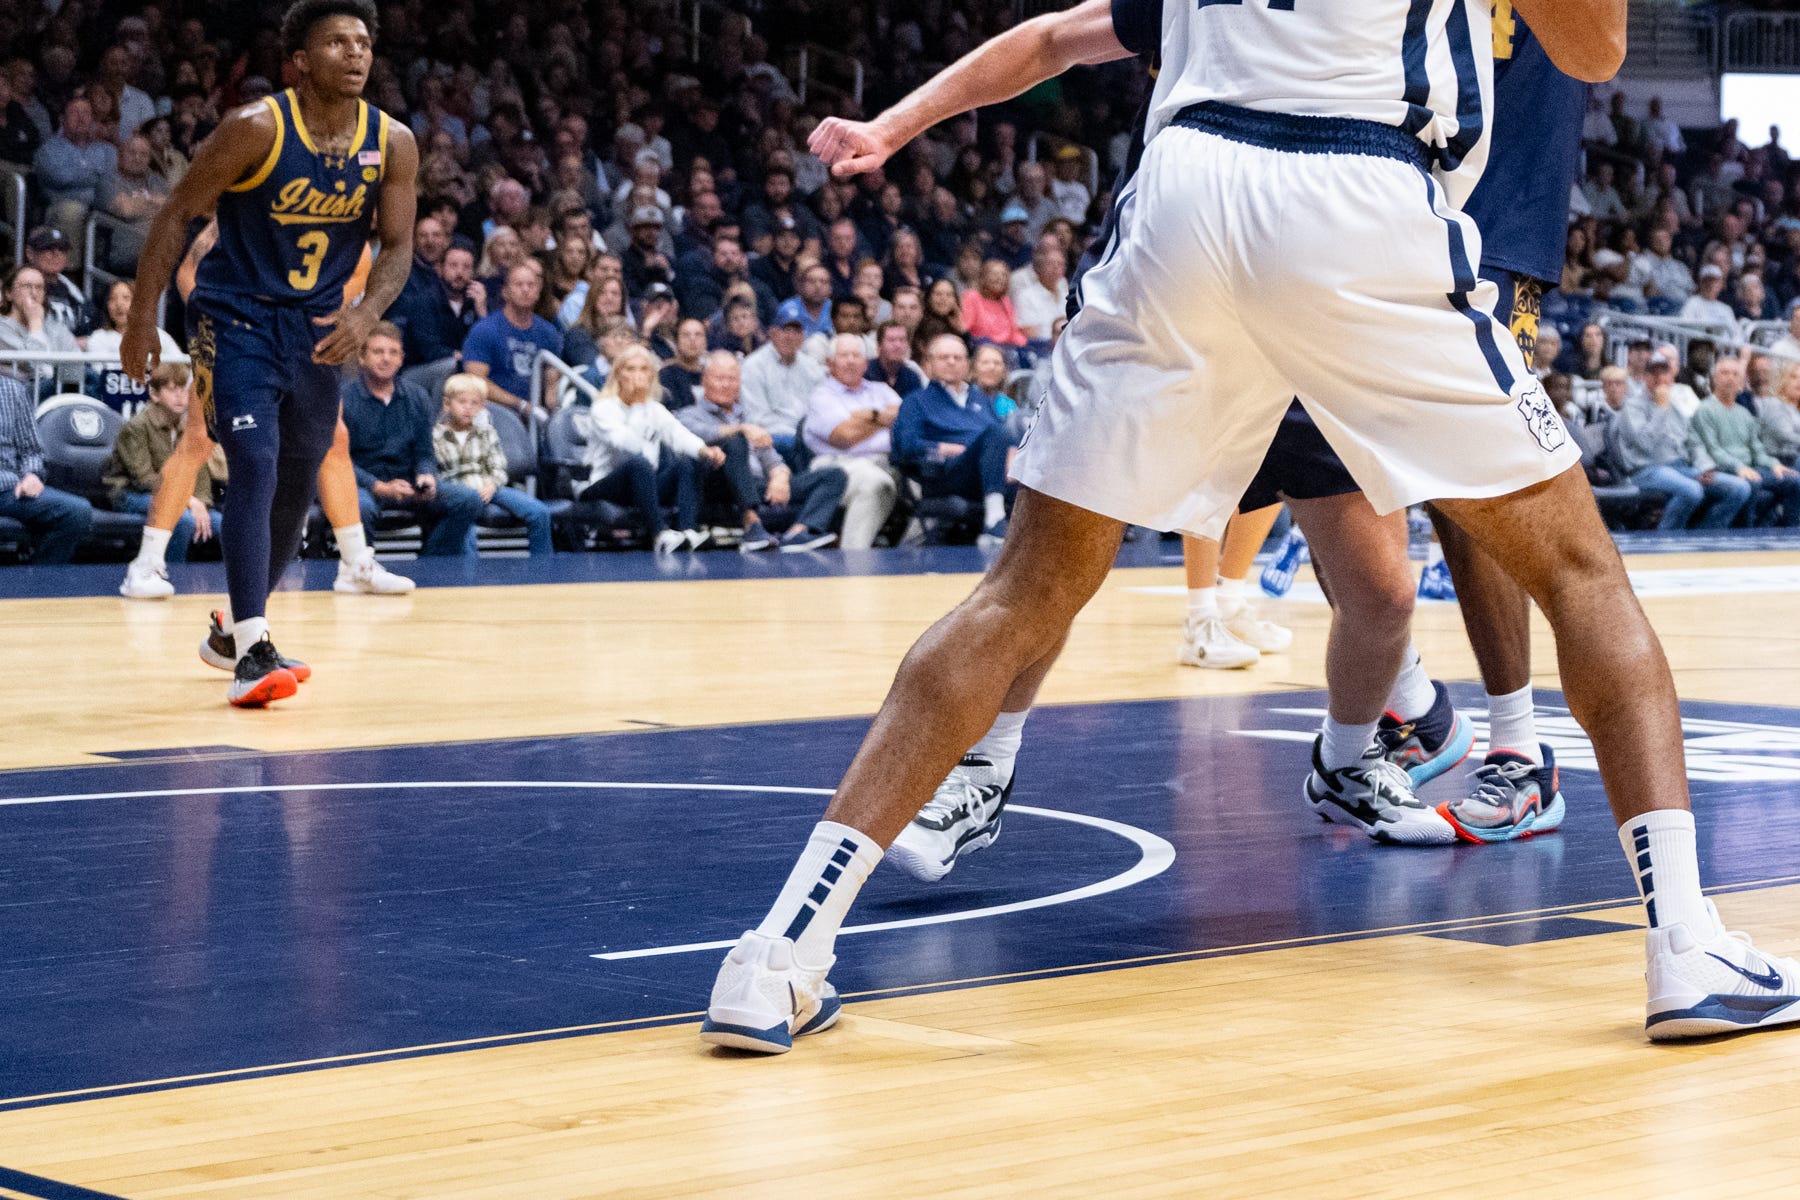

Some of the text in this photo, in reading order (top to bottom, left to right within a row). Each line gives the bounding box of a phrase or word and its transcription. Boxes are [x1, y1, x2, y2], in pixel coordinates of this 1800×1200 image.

[271, 177, 367, 218] Irish
[288, 230, 330, 291] 3
[105, 372, 151, 395] SEC
